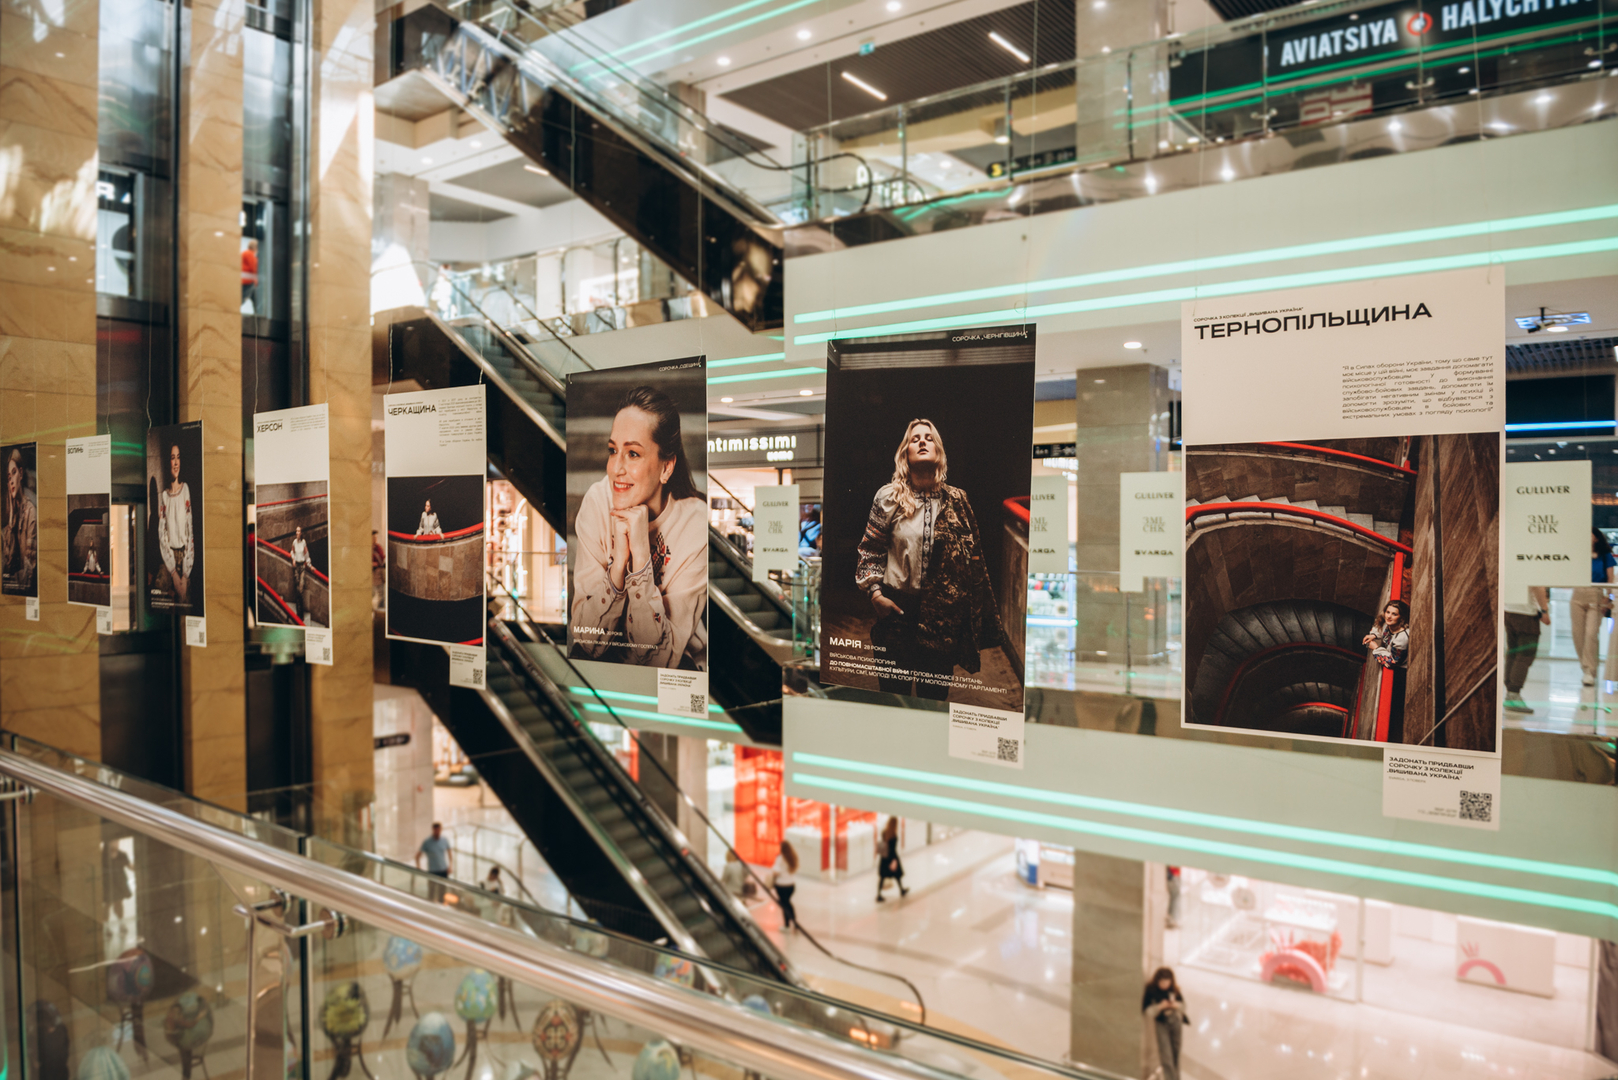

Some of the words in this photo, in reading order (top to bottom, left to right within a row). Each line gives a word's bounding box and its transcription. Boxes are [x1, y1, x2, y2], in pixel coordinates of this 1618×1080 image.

[1280, 18, 1398, 66] AVIATSIYA
[1194, 302, 1432, 340] ТЕРНОПІЛЬЩИНА
[1342, 375, 1412, 383] військовослужбовцям
[1342, 388, 1402, 396] службово-бойових
[388, 404, 436, 415] ЧЕРКАЩИНА
[257, 422, 282, 433] ХЕРСОН
[708, 436, 796, 452] ntimissimi
[766, 450, 794, 462] uomo
[1516, 486, 1570, 494] GULLIVER
[574, 626, 605, 635] МАРИНА
[830, 637, 862, 648] МАРІЯ
[829, 652, 856, 660] ВІЙСЬКОВА
[857, 656, 896, 665] ПСИХОЛОГИНЯ
[839, 661, 892, 672] ПОВНОМАСШТАБНОЇ
[925, 679, 968, 688] МОЛОДІЖНОМУ
[969, 685, 1008, 694] ПАРЛАМЕНТІ
[1389, 757, 1427, 765] ЗАДОНАТЬ
[1428, 760, 1474, 769] ПРИДБАВШИ
